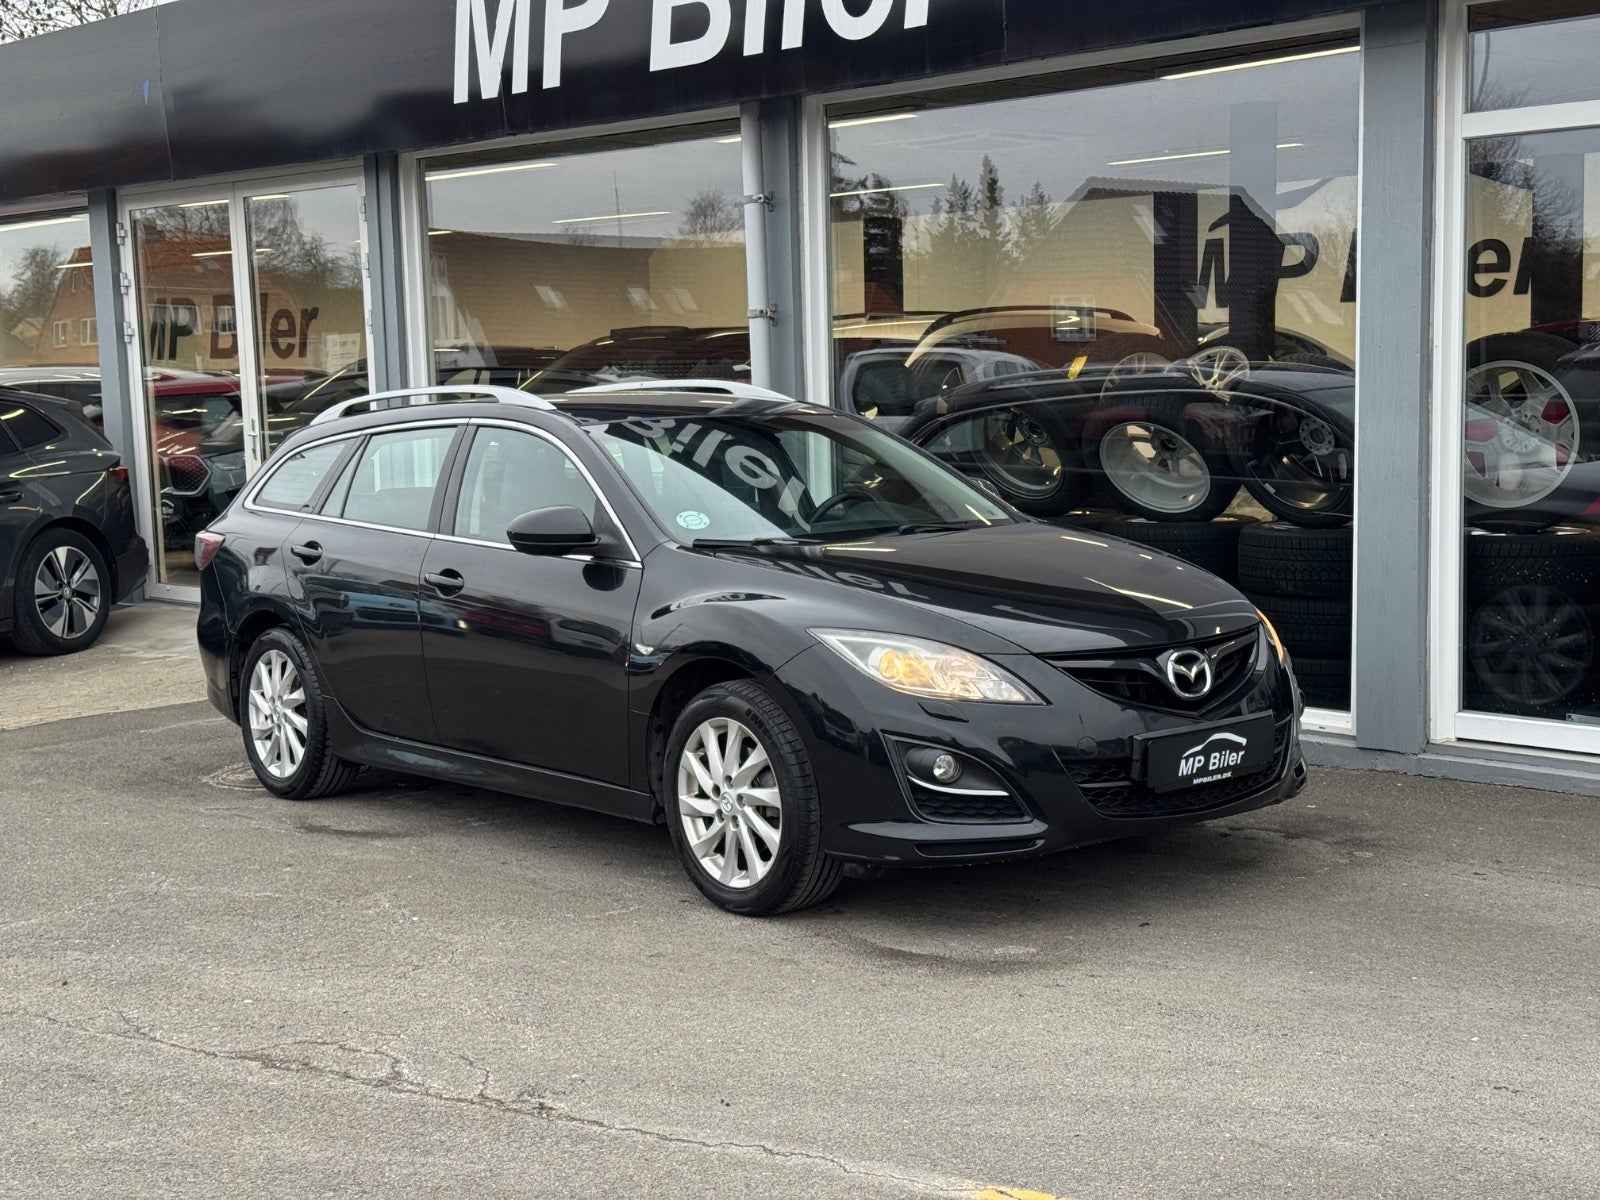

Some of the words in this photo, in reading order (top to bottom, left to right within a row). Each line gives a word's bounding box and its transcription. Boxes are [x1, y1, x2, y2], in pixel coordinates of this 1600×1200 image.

[453, 0, 610, 104] MP
[1178, 755, 1205, 777] MP
[1208, 750, 1246, 771] Biler
